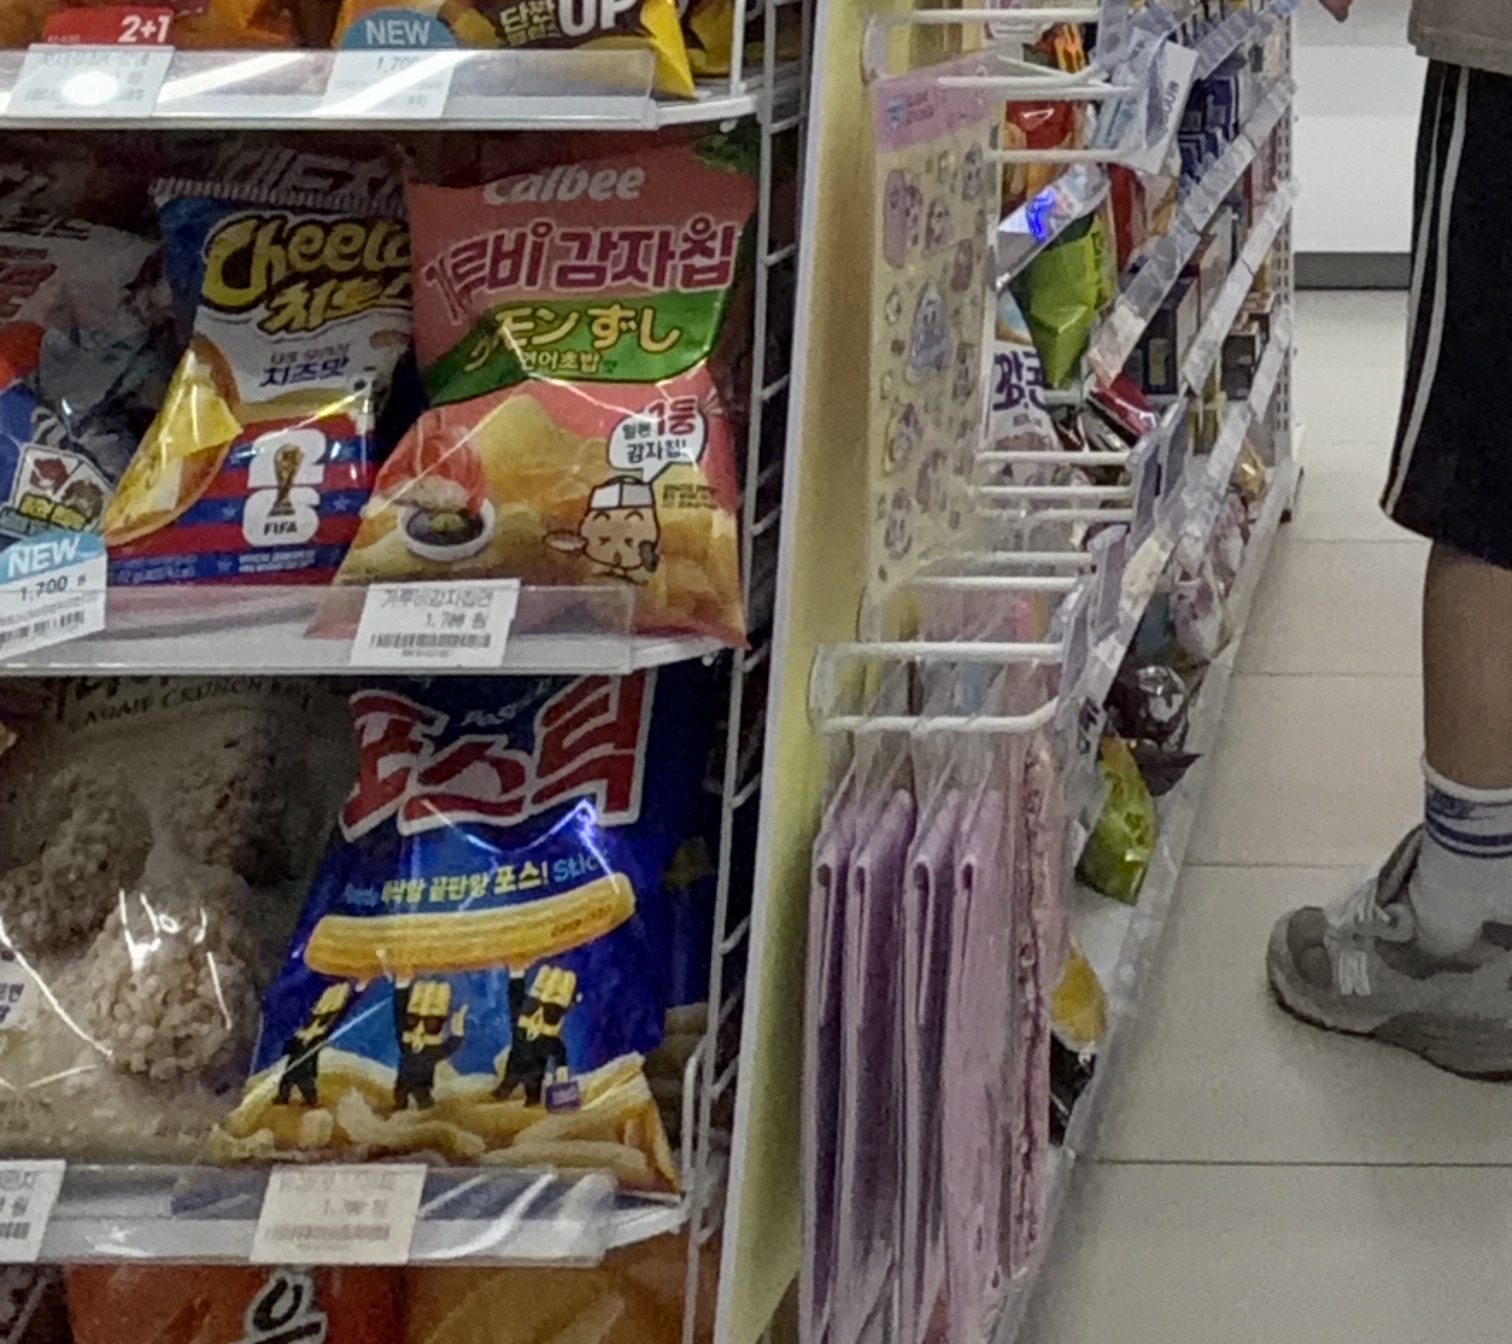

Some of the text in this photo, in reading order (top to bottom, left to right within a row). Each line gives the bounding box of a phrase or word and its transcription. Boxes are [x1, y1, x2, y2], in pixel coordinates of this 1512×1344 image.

[117, 14, 171, 44] 2+1
[365, 20, 431, 46] NEW
[482, 163, 647, 206] Calbee
[202, 213, 412, 312] Cheet
[259, 355, 352, 389] 치즈맛
[643, 397, 699, 436] 1등
[263, 520, 299, 538] FIFA
[7, 537, 81, 581] NEW
[19, 573, 69, 603] 1,700
[427, 868, 488, 904] 끝판왕
[492, 863, 550, 897] 포스!
